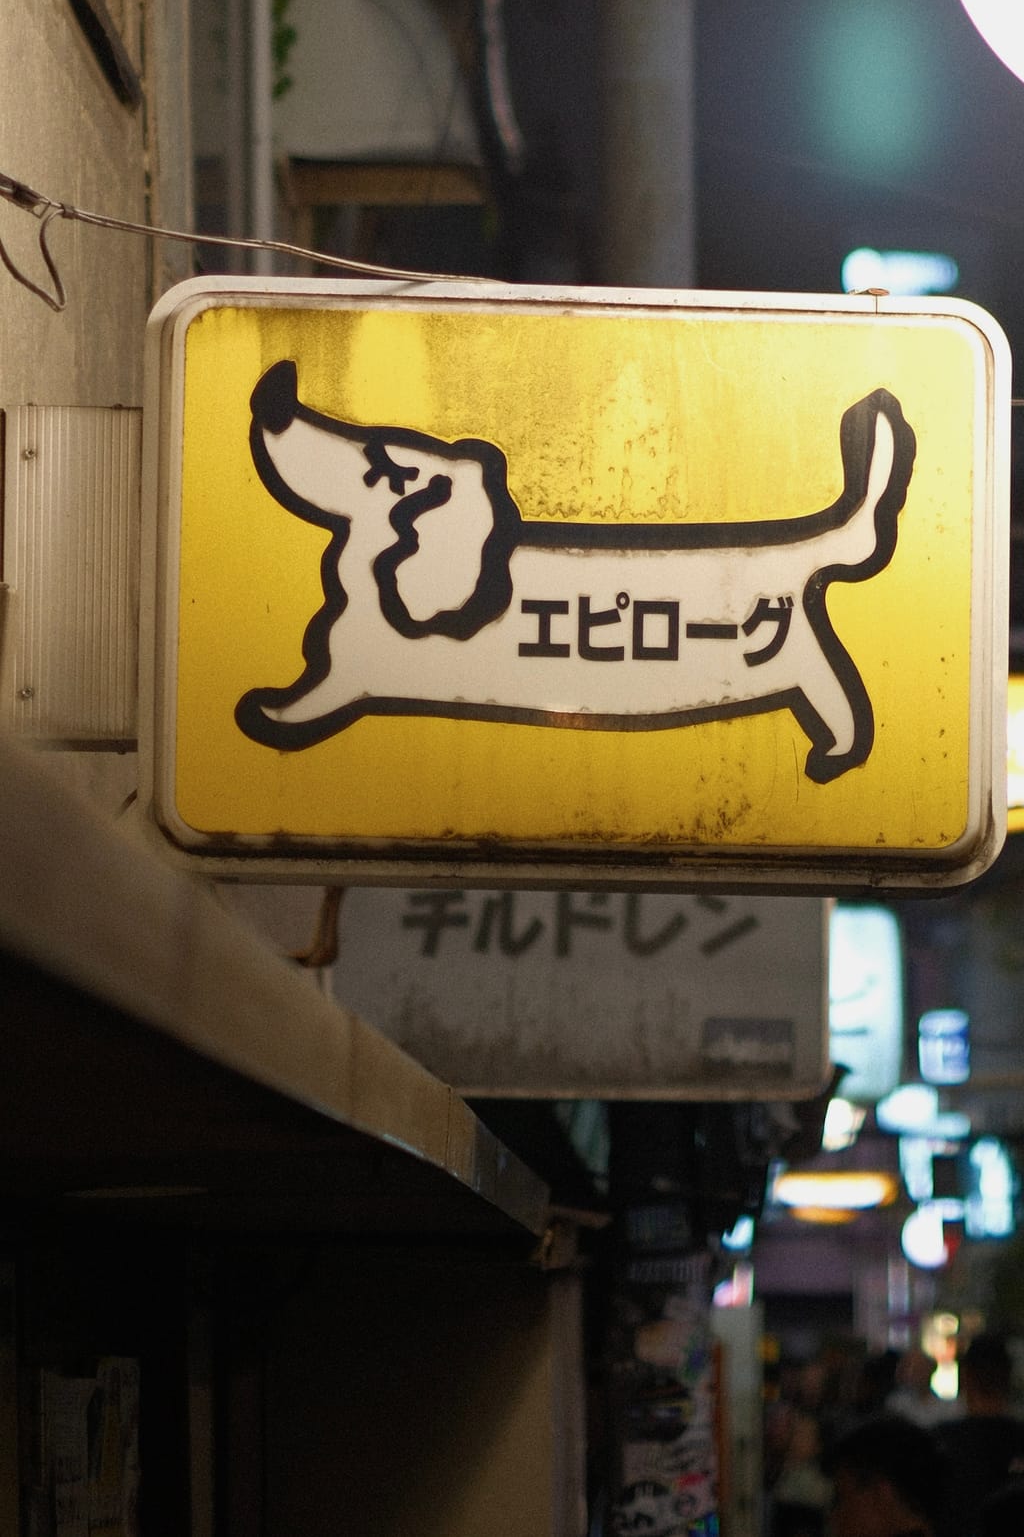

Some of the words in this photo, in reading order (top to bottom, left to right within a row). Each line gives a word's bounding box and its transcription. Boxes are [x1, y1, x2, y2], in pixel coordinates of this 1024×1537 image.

[518, 591, 795, 668] エピローグ
[401, 889, 759, 959] チルドレン
